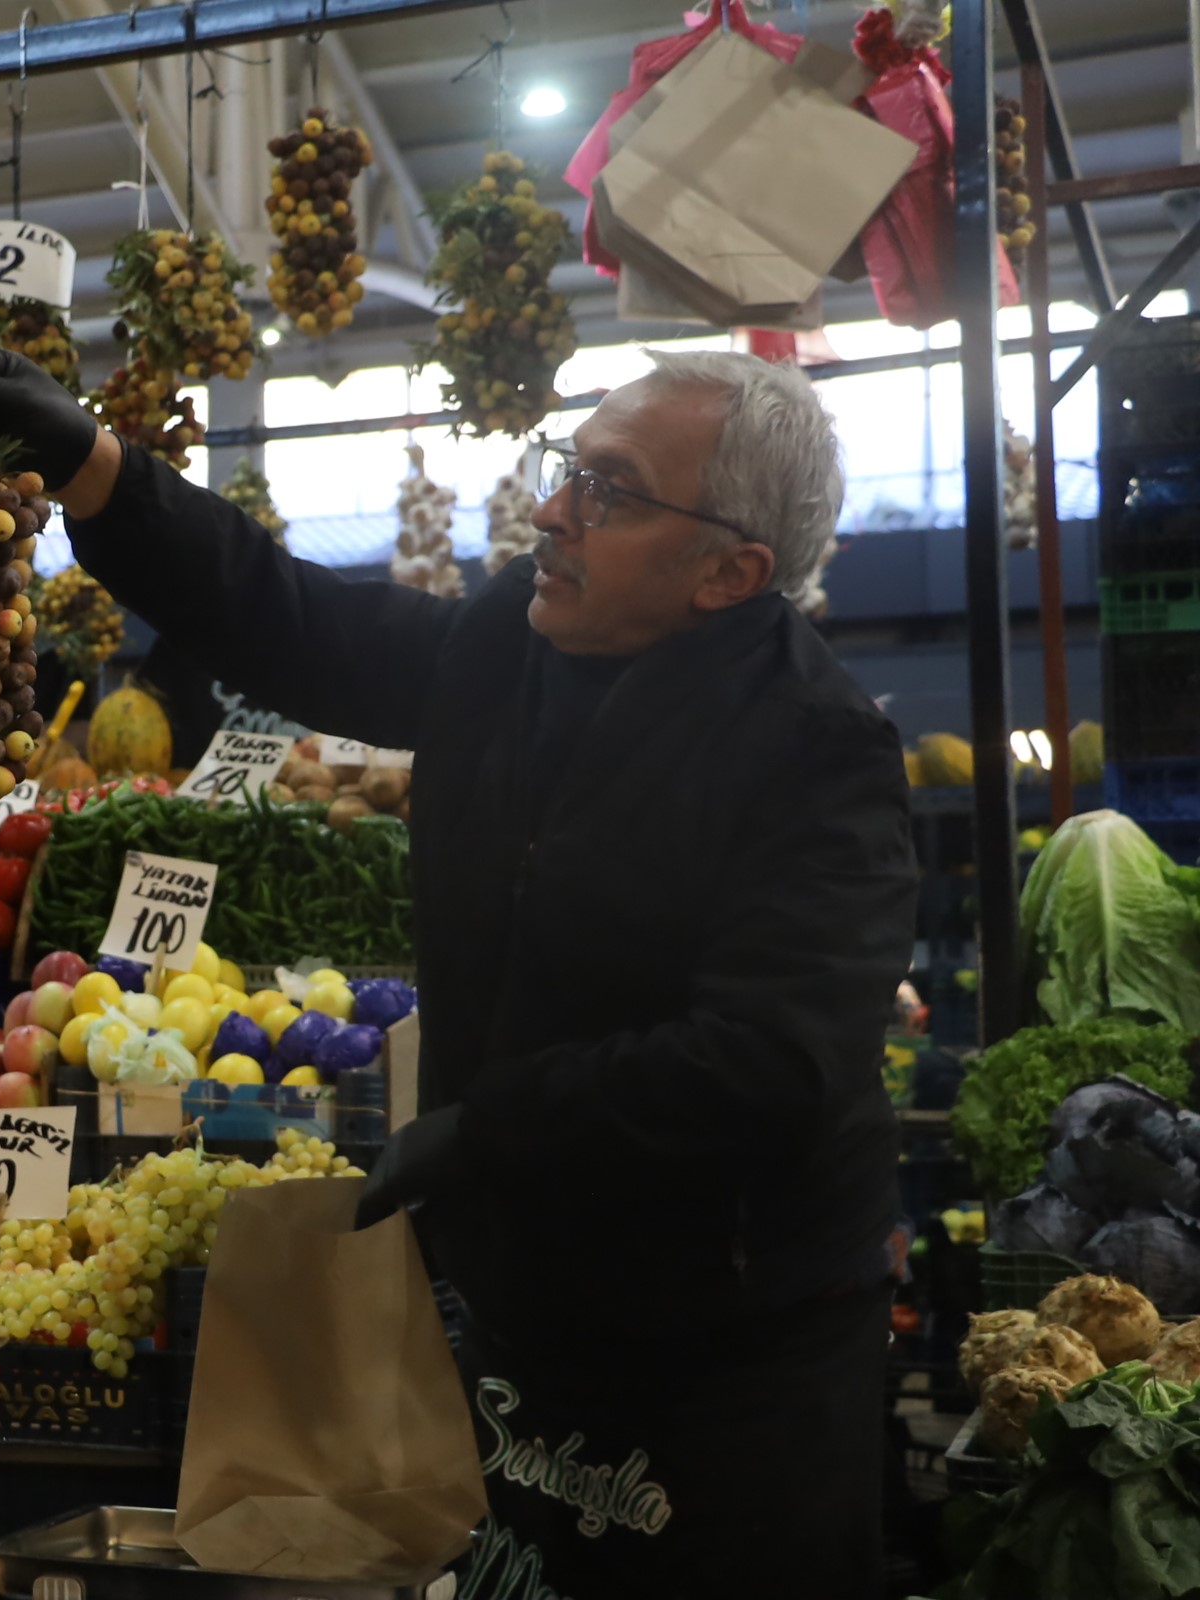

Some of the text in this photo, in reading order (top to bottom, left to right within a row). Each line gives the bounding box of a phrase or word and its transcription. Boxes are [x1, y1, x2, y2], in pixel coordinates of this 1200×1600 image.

[191, 766, 250, 795] 60
[141, 864, 209, 893] YATAK
[125, 907, 186, 955] 100
